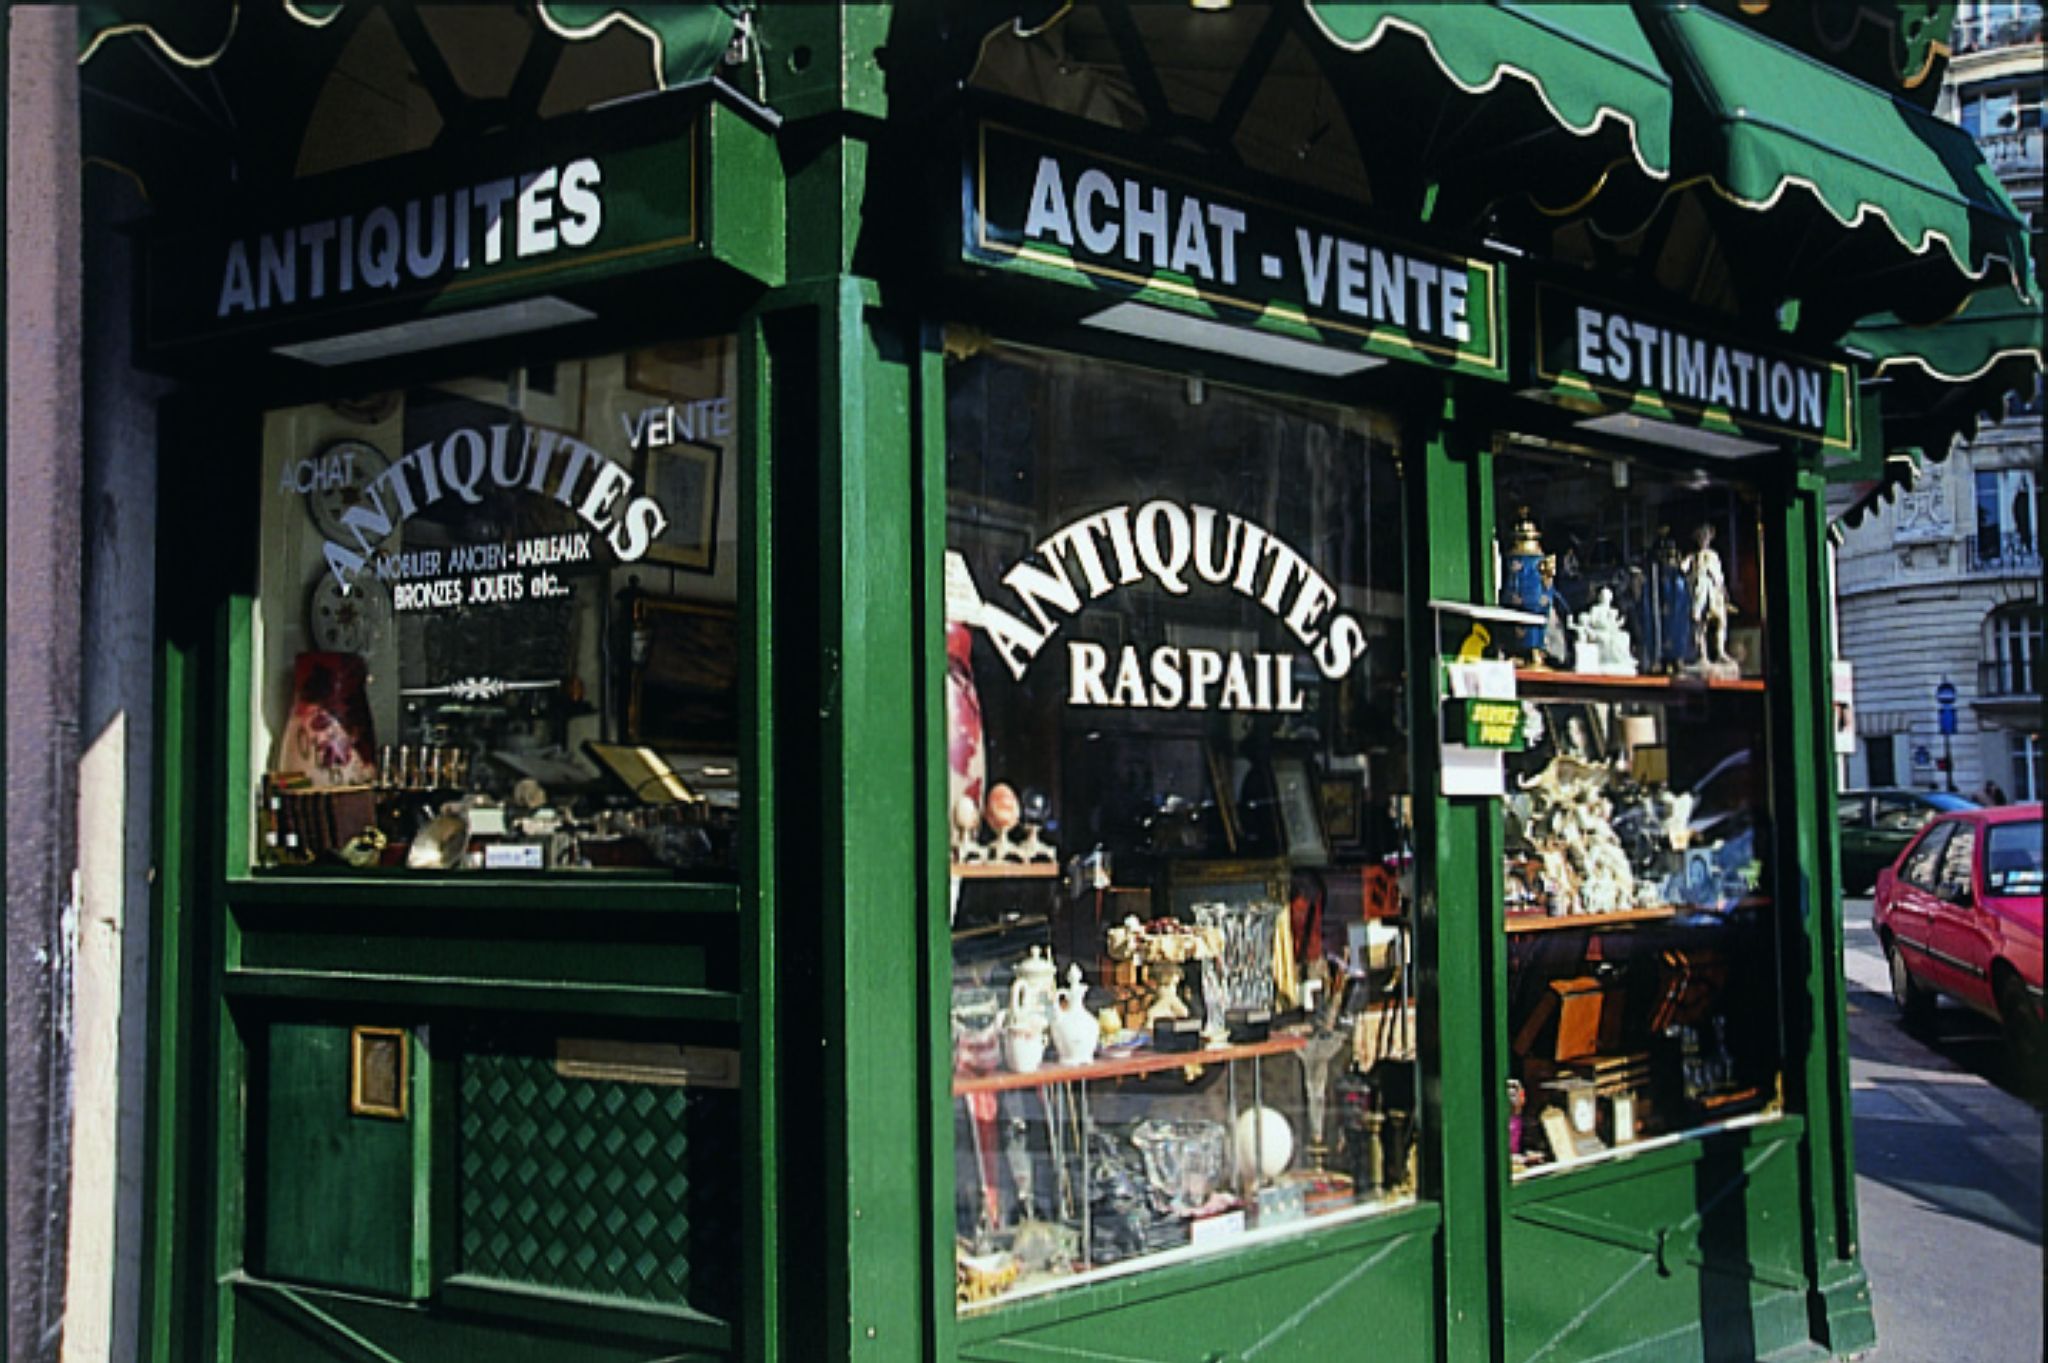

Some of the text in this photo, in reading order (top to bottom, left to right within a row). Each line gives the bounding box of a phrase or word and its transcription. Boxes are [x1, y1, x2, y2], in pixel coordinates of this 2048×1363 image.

[218, 158, 600, 316] ANTIQUITES
[1025, 157, 1245, 284] ACHAT
[1296, 228, 1471, 341] VENTE
[621, 398, 731, 448] VENTE
[1577, 307, 1823, 429] ESTIMATION
[278, 453, 355, 495] ACHAT
[323, 426, 667, 596] ANTIQUITES
[394, 578, 463, 610] BRONZES
[468, 572, 523, 603] JOUETS
[982, 501, 1368, 680] ANTIQUITES
[1068, 642, 1303, 712] RASPAIL
